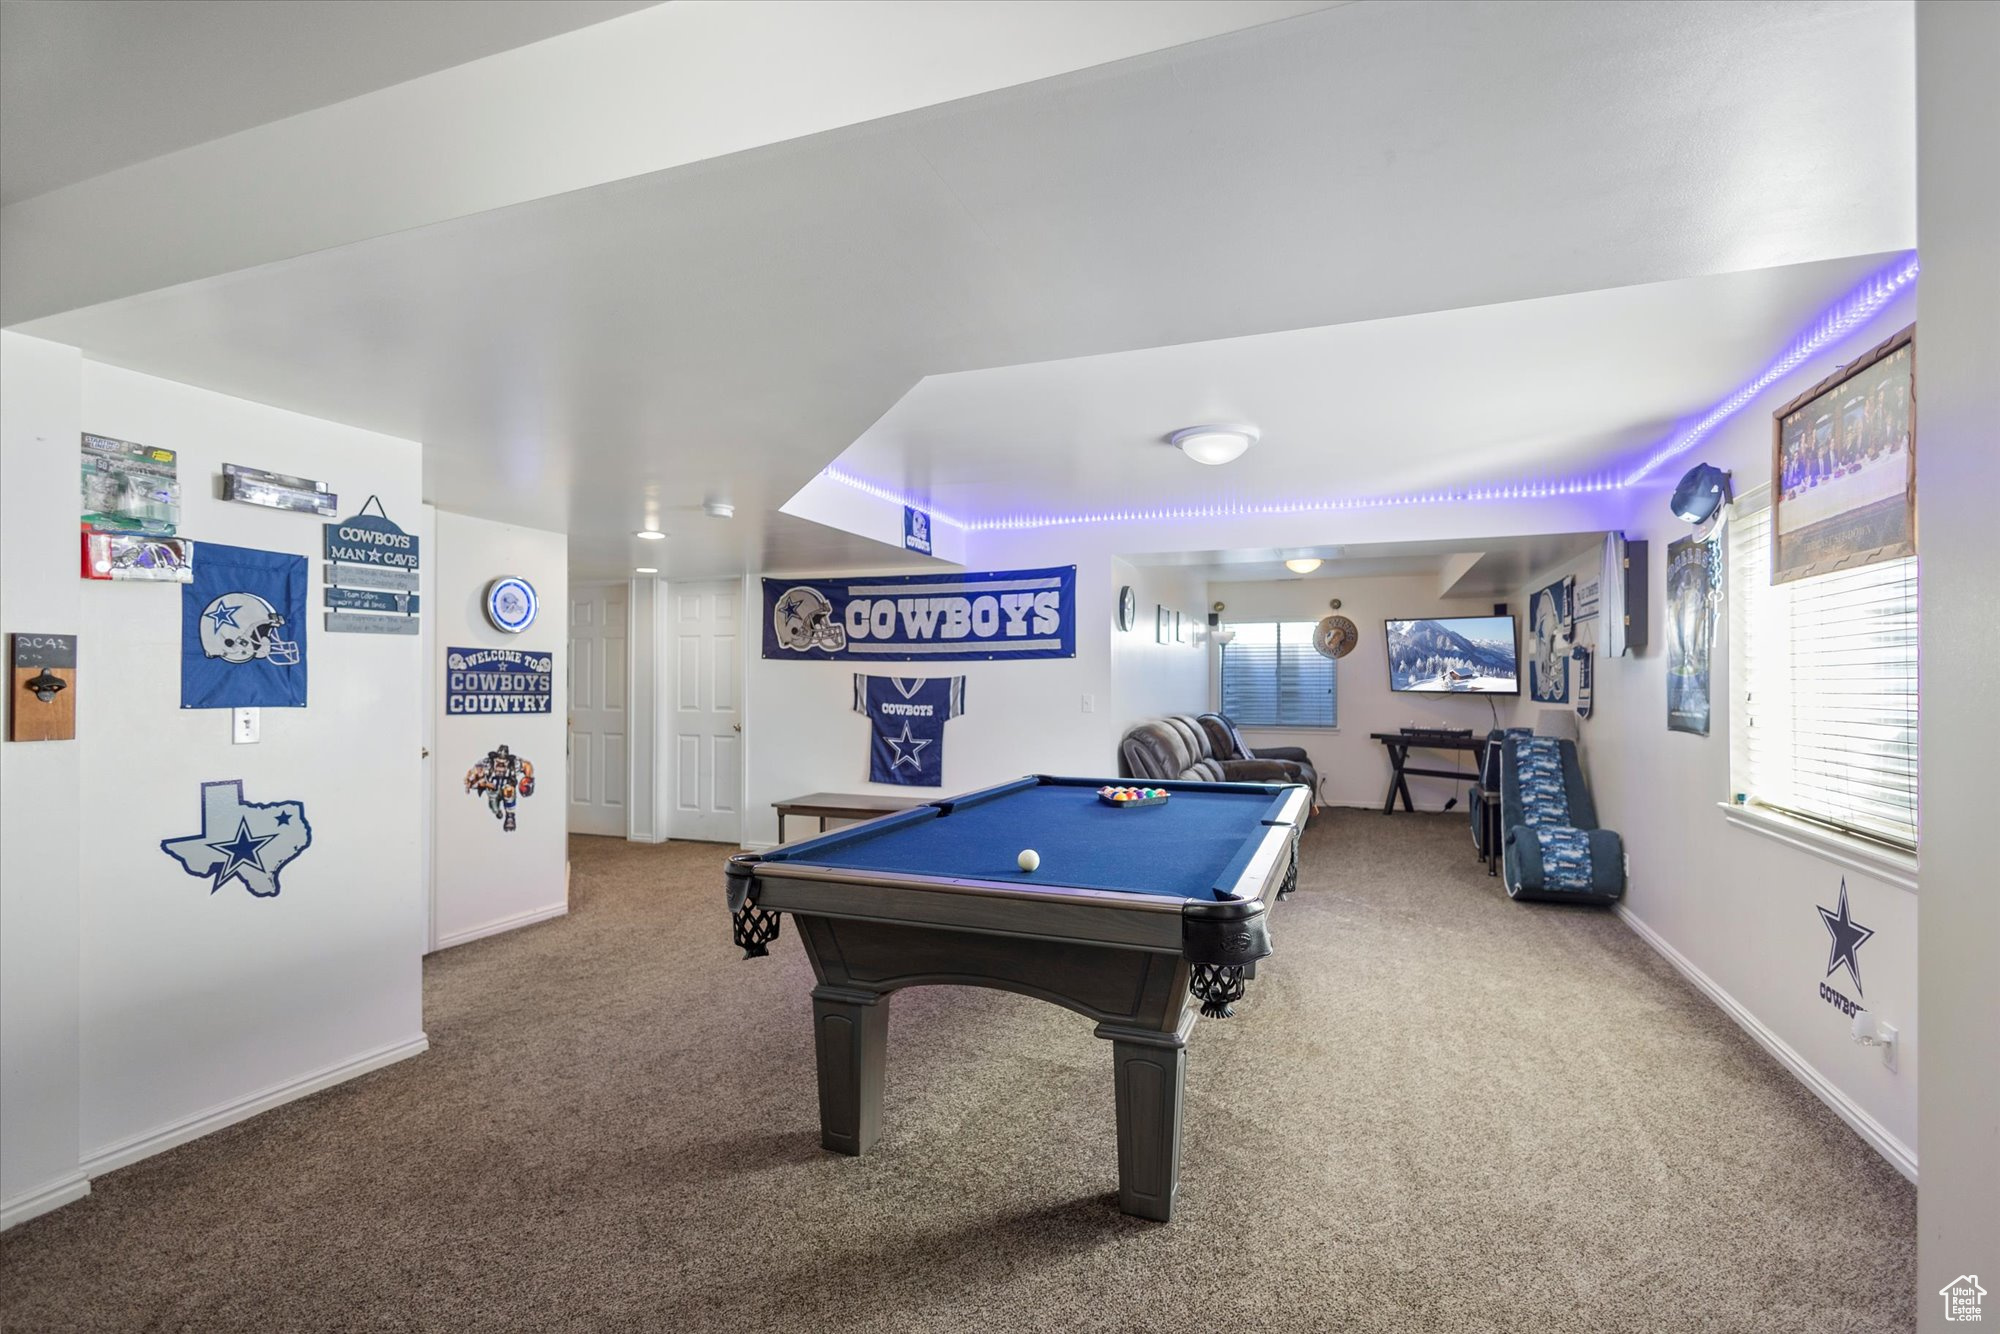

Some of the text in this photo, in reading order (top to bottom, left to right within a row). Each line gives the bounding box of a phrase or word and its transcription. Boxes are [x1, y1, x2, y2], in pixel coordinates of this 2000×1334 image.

[339, 527, 410, 548] COWBOYS
[331, 546, 417, 567] MAN CAVE
[1668, 547, 1708, 581] DALLAS
[845, 591, 1061, 639] COWBOYS
[465, 650, 538, 670] WELCOME TO
[451, 673, 550, 691] COWBOYS
[450, 694, 549, 713] COUNTRY
[881, 702, 933, 716] COWBOYS
[1820, 981, 1869, 1019] COWBO
